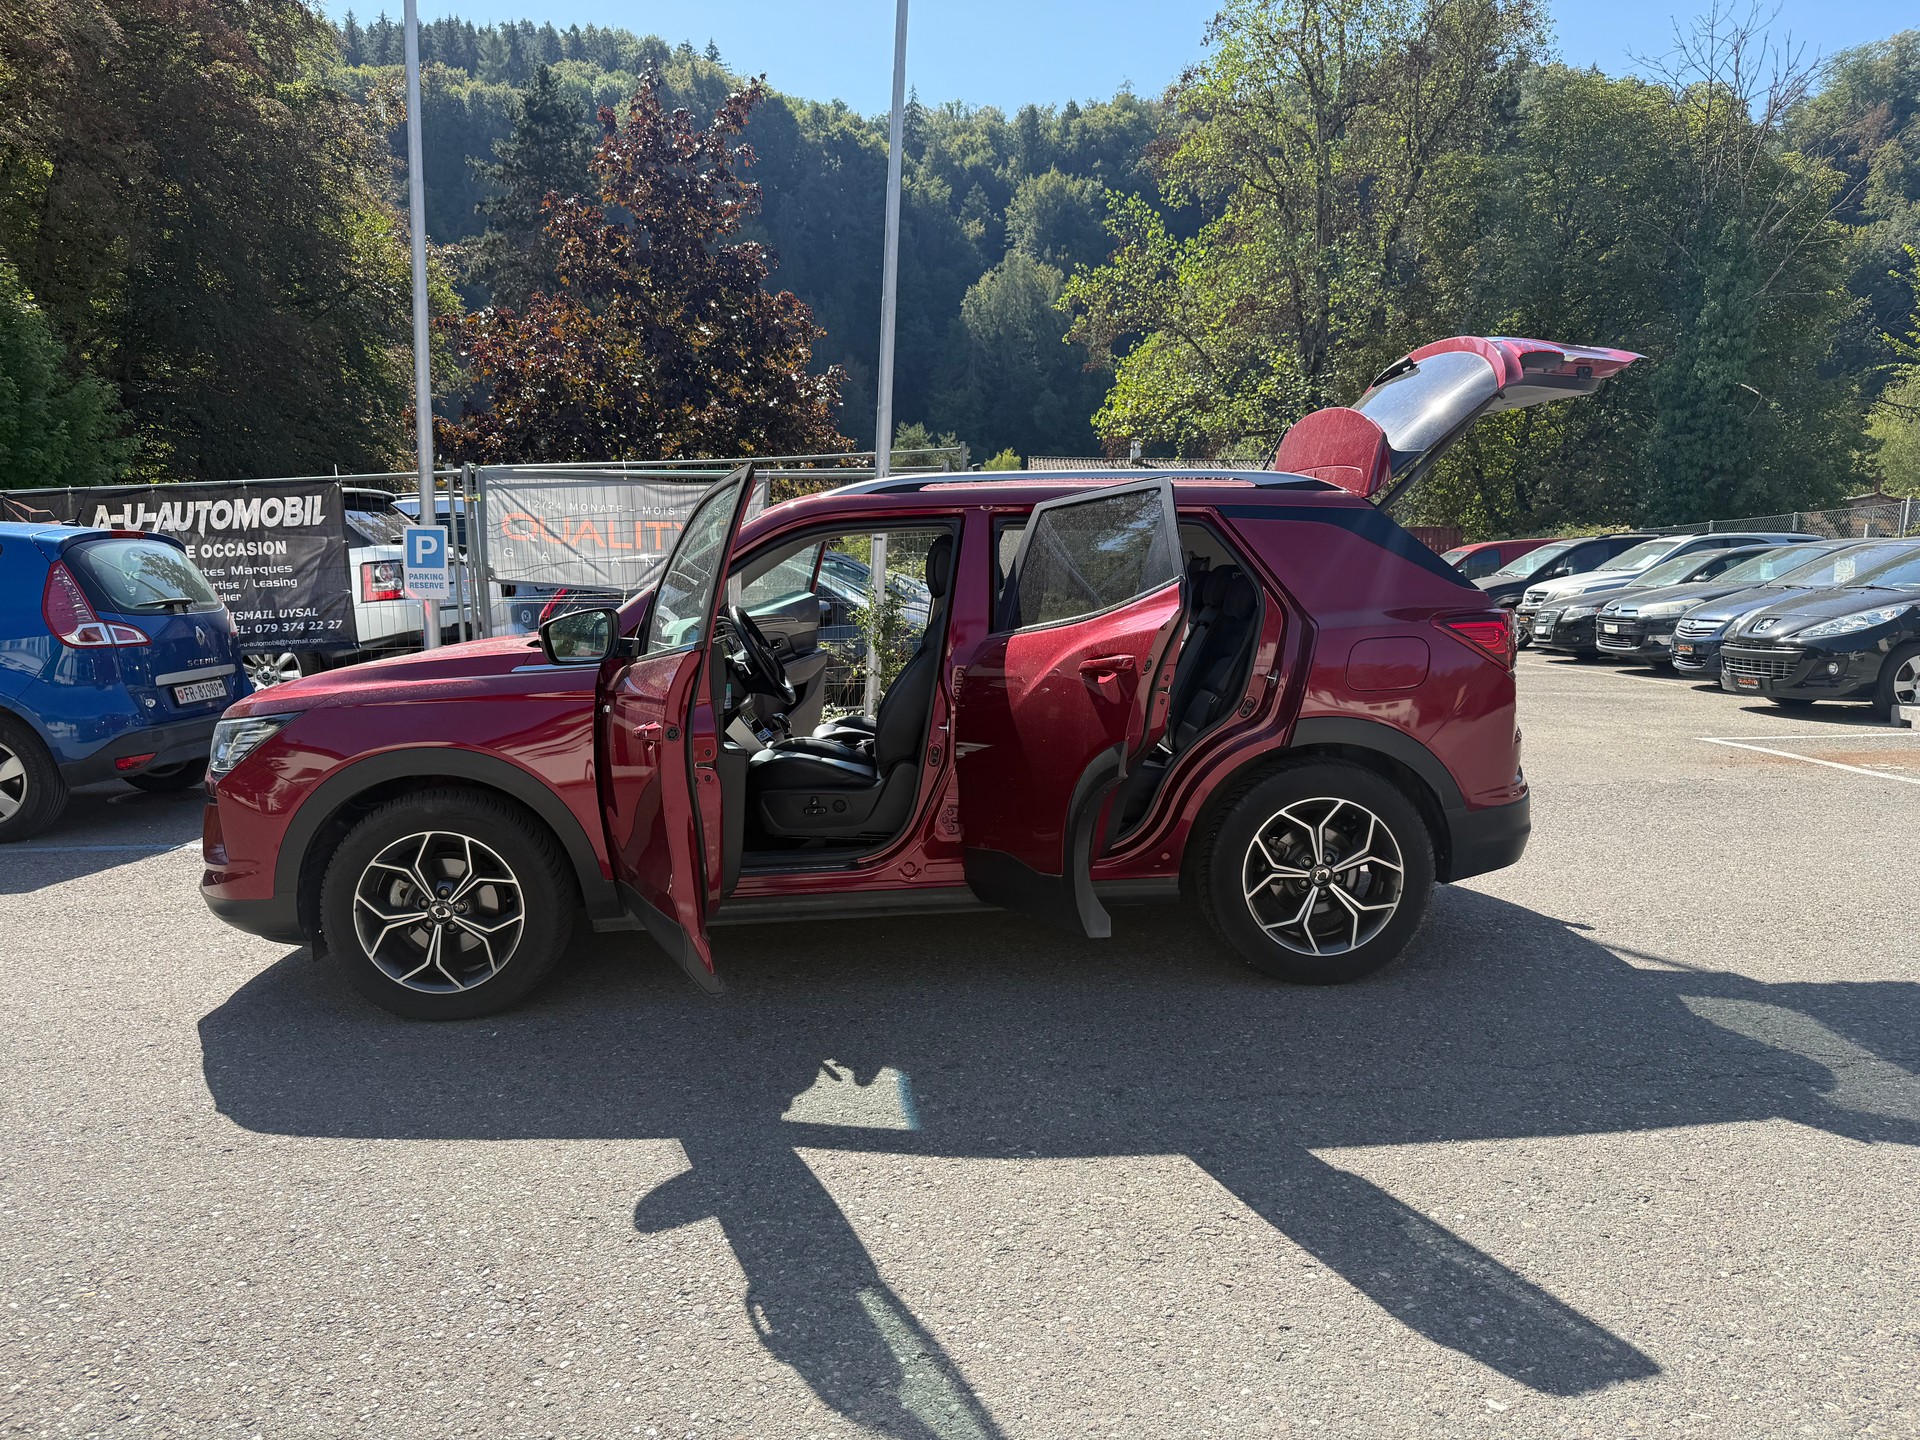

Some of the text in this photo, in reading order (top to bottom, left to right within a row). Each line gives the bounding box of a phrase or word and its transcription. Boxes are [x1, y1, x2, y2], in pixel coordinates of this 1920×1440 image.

[526, 500, 561, 509] 12/24
[569, 502, 623, 513] MONATE
[642, 506, 675, 515] MOIS
[92, 495, 326, 538] A-U-AUTOMOBIL
[185, 541, 287, 559] E OCCASION
[416, 536, 438, 564] P
[503, 547, 655, 567] GARAN
[230, 565, 293, 577] Marques
[210, 580, 240, 590] rtise
[252, 578, 298, 588] Leasing
[218, 592, 242, 602] elier
[230, 608, 319, 620] ISMAIL UYSAL
[236, 620, 343, 634] EL: 079 374 22 27
[239, 637, 323, 648] -u-automobil@hotmail.com
[187, 656, 219, 667] SCENIC
